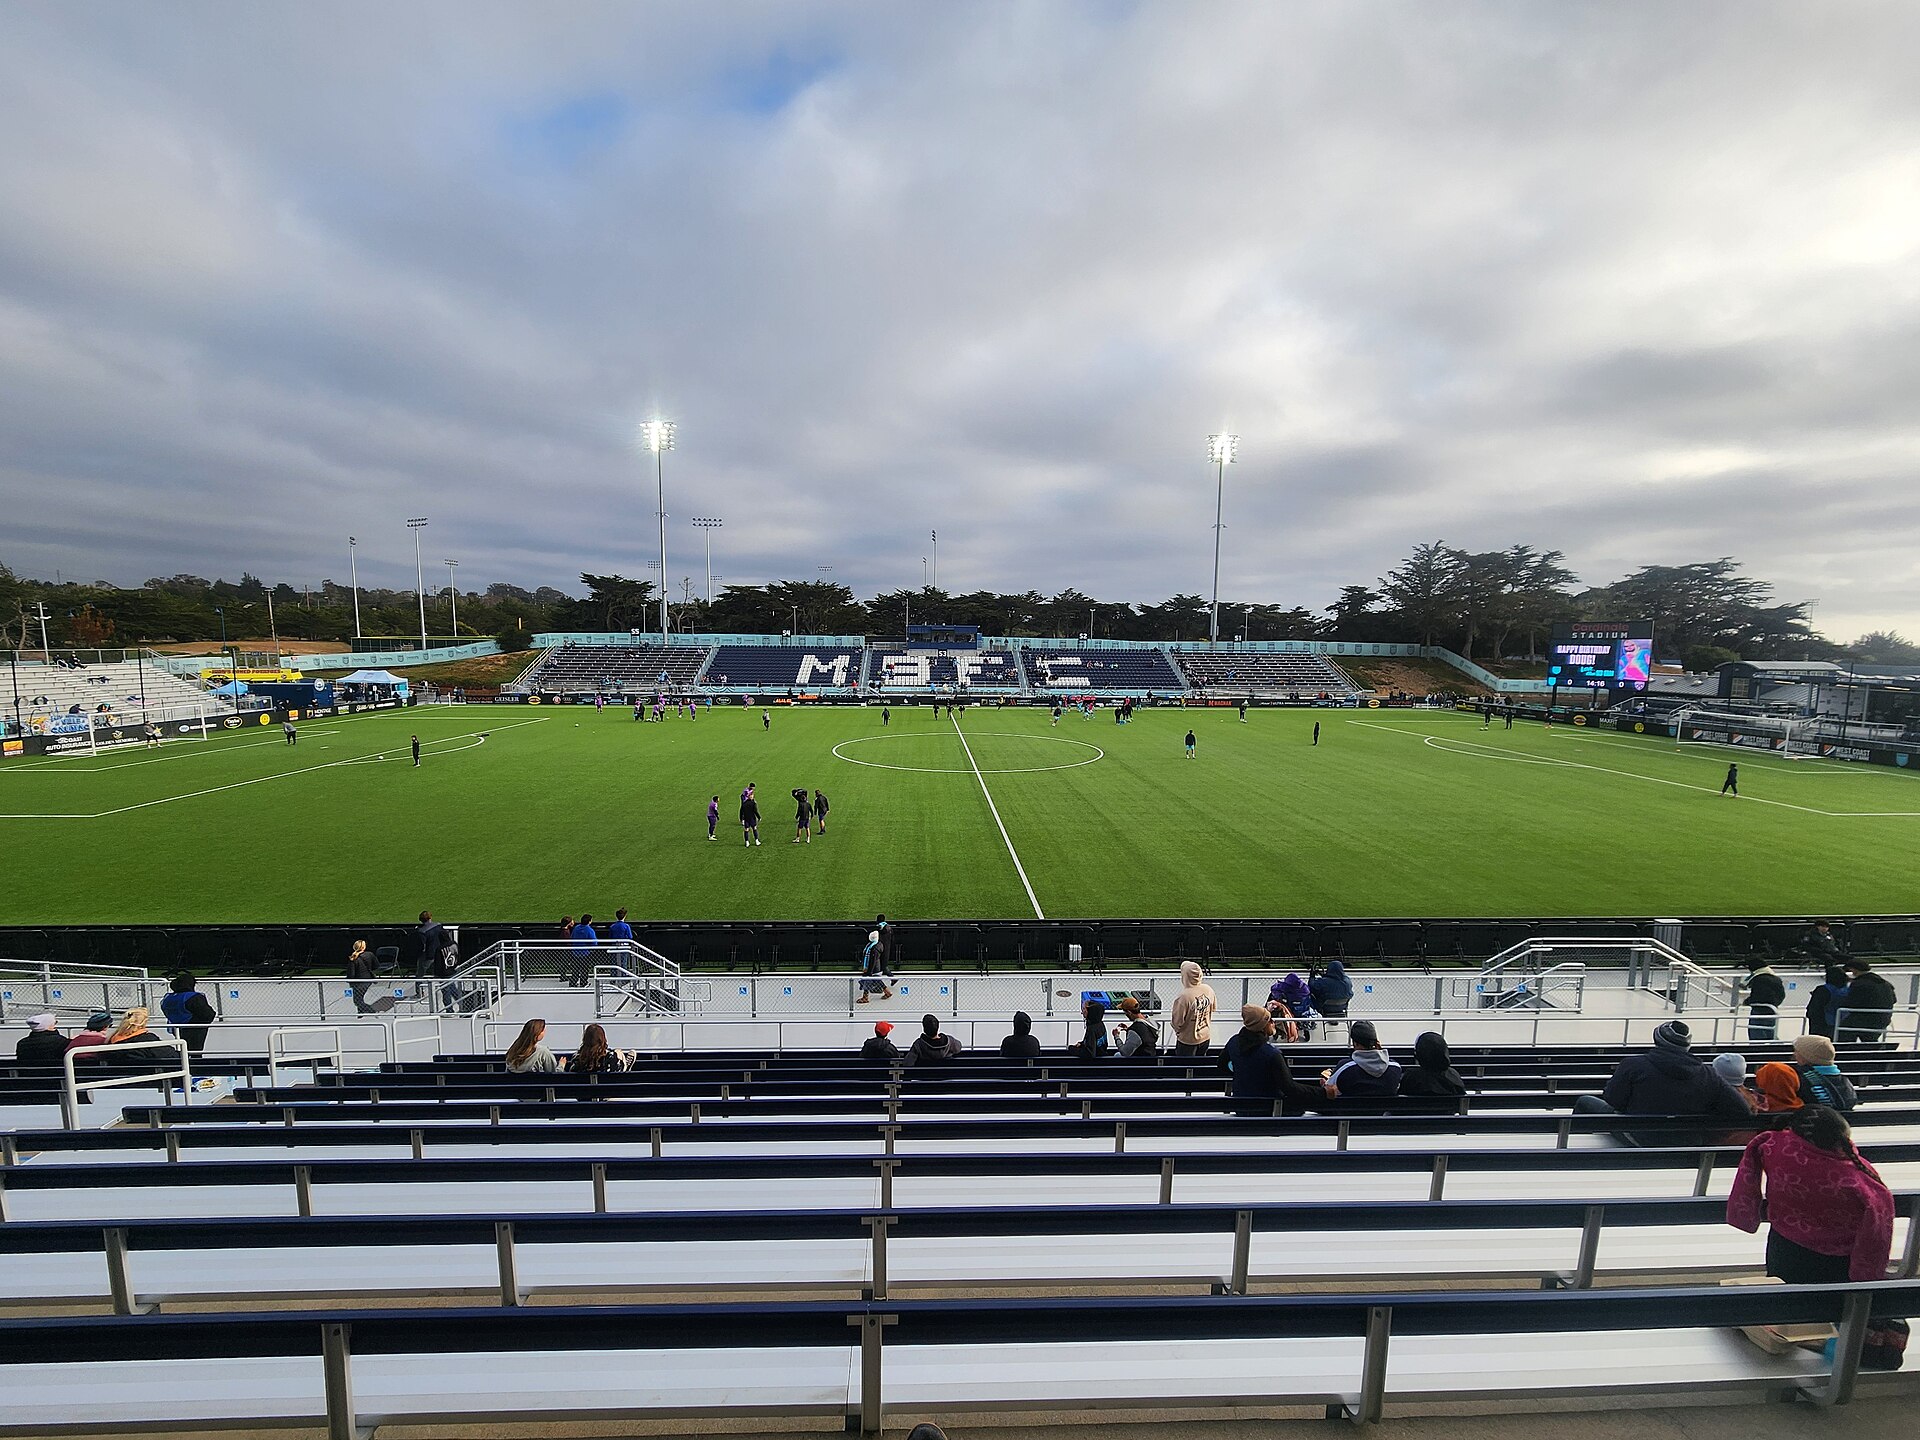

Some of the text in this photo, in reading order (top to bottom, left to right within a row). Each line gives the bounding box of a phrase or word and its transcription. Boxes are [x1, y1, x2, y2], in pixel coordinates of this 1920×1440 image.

[1572, 623, 1629, 632] Cardinale
[1557, 645, 1611, 654] HAPPY BIRTHDAY
[1569, 654, 1596, 664] DOUG!
[1836, 746, 1870, 757] WEST COAST
